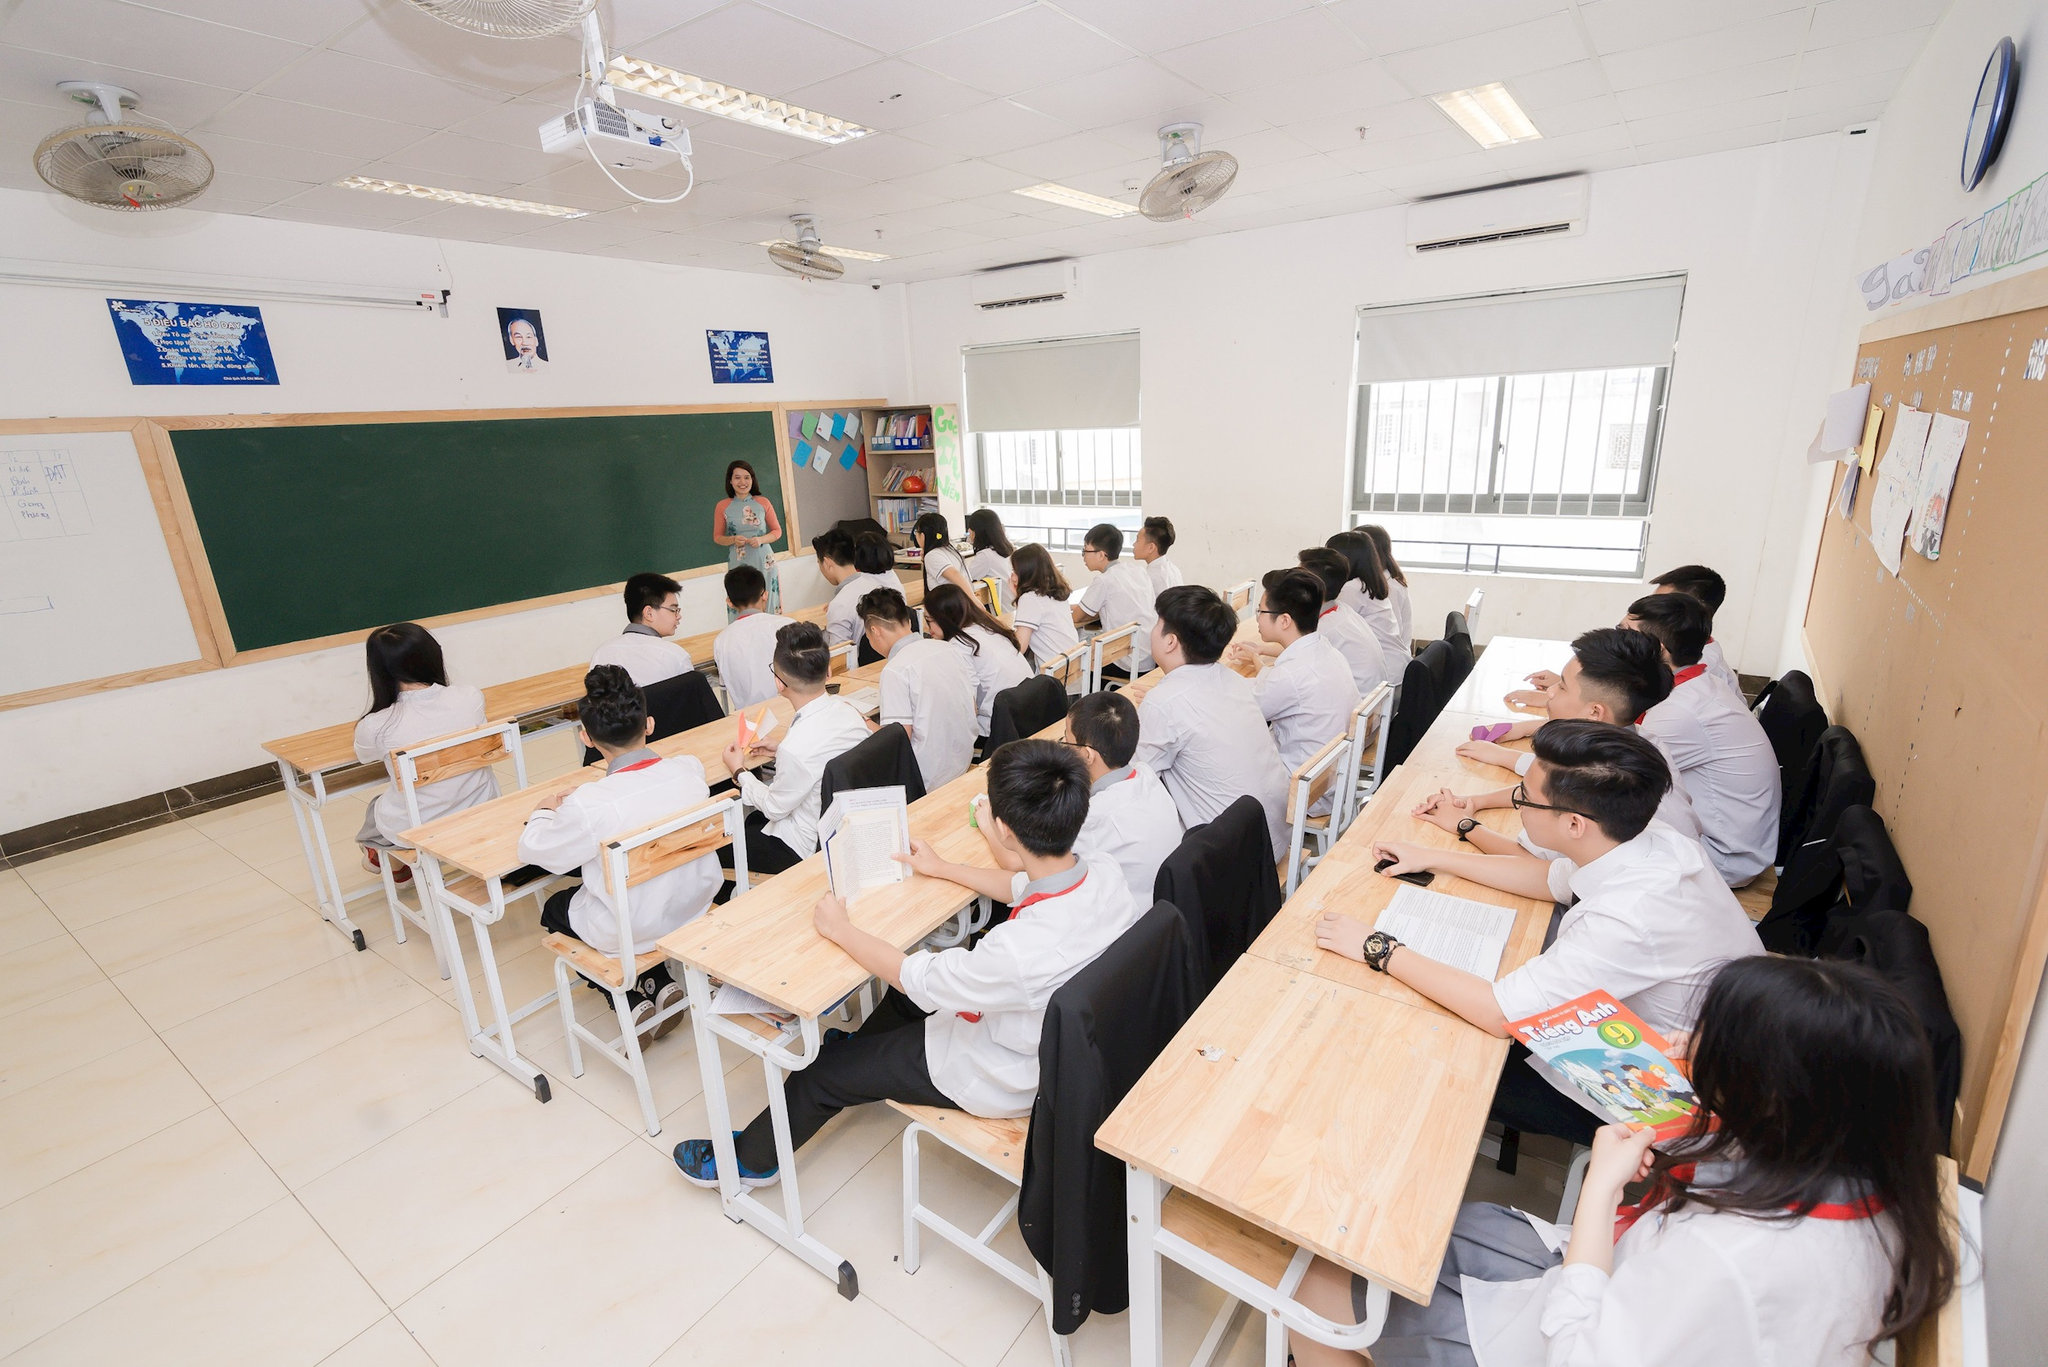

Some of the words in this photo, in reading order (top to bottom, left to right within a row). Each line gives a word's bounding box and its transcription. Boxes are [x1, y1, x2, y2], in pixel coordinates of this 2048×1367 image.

[143, 318, 150, 326] 5
[1518, 1019, 1583, 1042] Tiếng
[1576, 1001, 1618, 1026] Anh
[1604, 1023, 1635, 1045] 9
